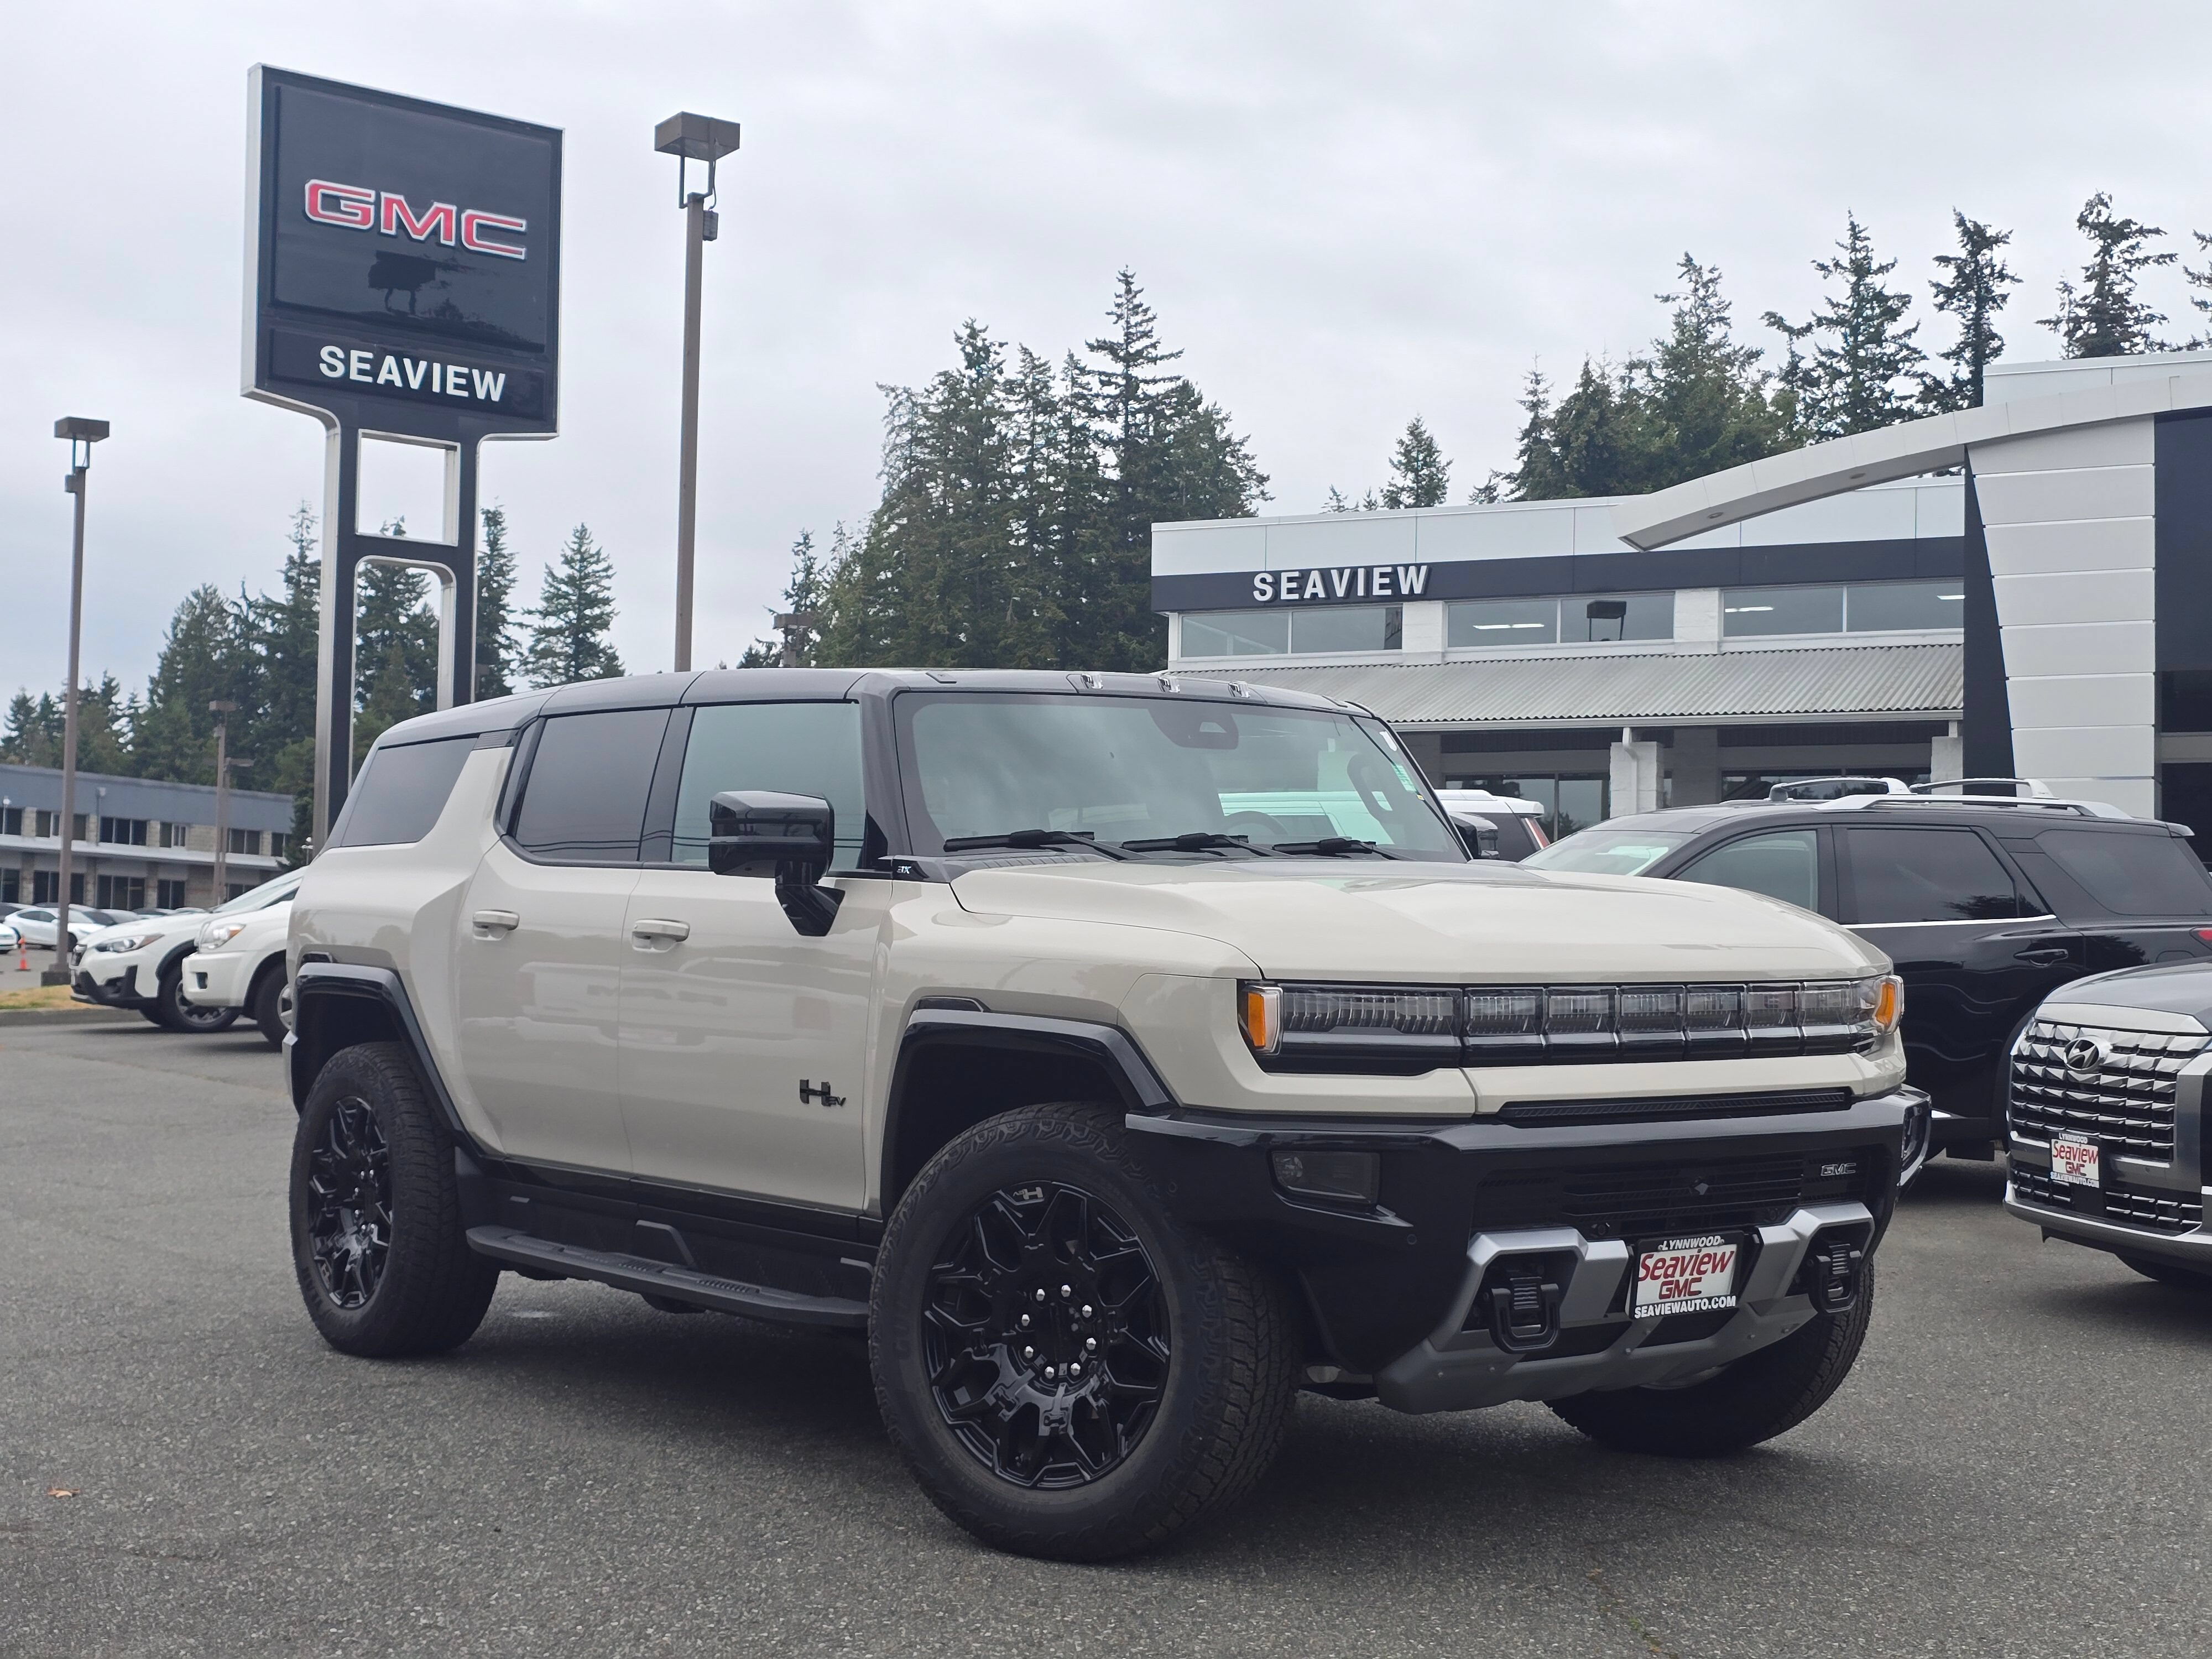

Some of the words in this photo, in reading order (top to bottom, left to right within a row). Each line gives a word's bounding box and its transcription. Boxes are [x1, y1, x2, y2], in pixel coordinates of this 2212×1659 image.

[305, 179, 528, 260] GMC
[319, 345, 506, 402] SEAVIEW
[1253, 565, 1429, 602] SEAVIEW
[2053, 1141, 2098, 1164] Seaview
[1820, 1163, 1856, 1176] GMC
[2065, 1161, 2086, 1176] GMC
[1662, 1235, 1720, 1251] LYNNWOOD
[1638, 1249, 1735, 1281] Seaview
[1658, 1277, 1702, 1300] GMC
[1635, 1295, 1736, 1318] SEAVIEWAUTO.COM
